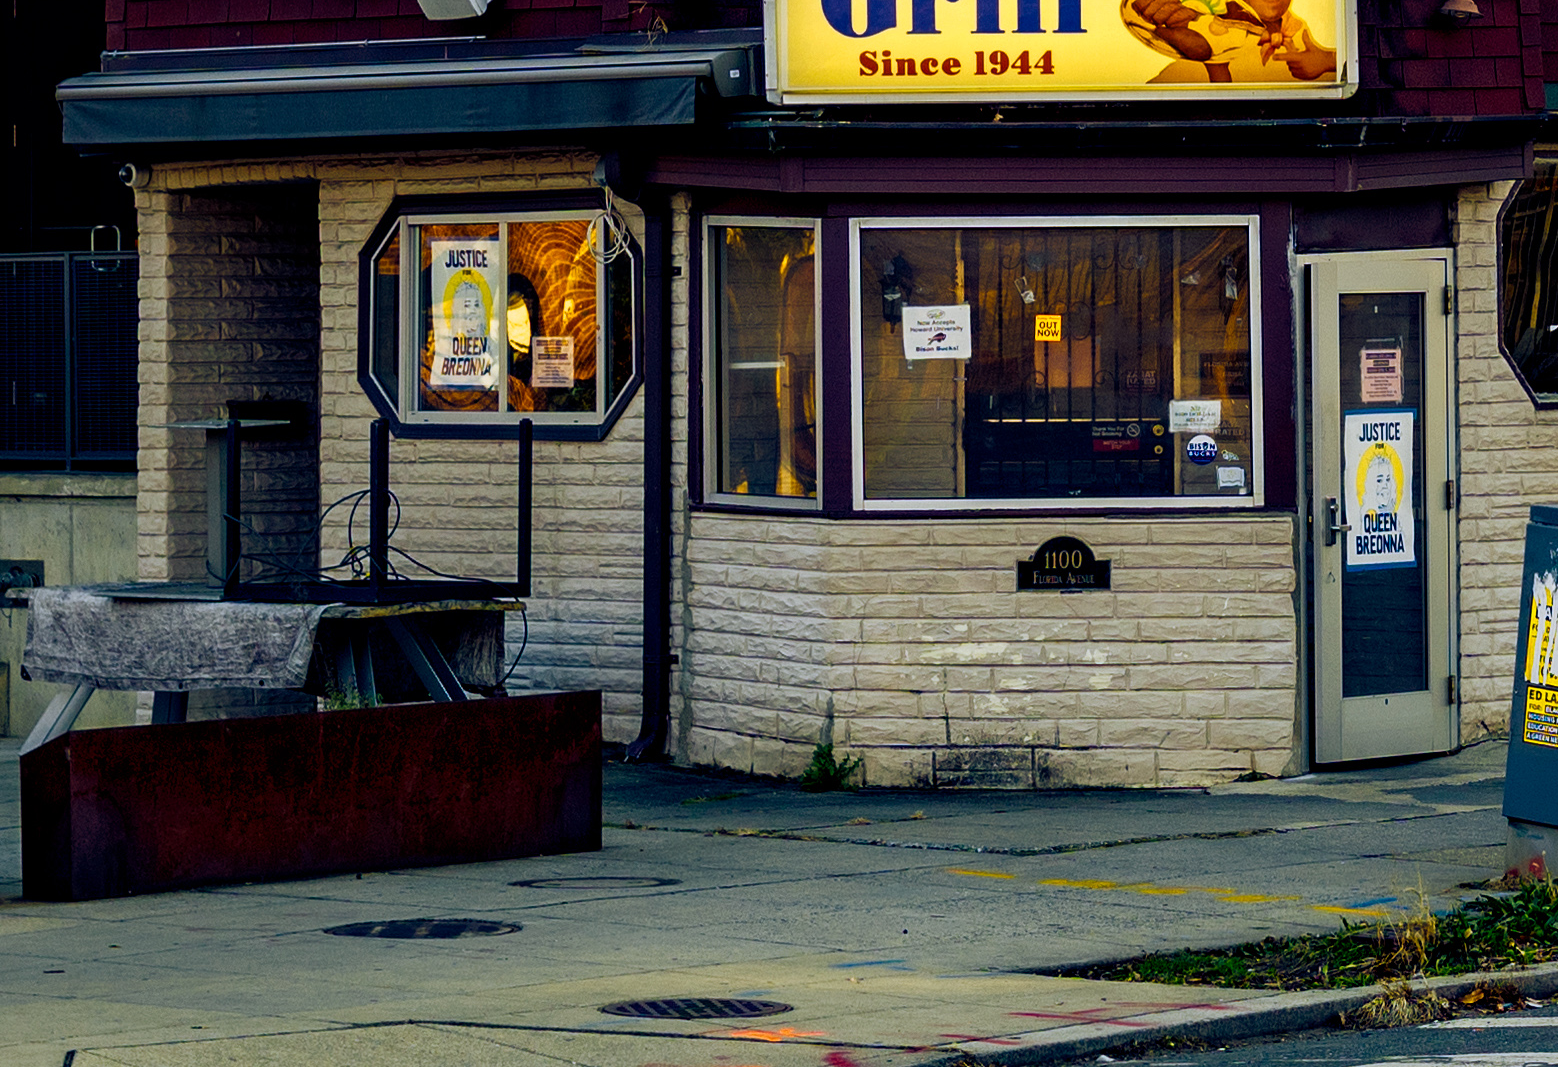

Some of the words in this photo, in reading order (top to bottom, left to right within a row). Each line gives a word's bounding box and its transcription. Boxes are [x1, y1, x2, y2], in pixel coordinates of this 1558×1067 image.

[859, 50, 961, 76] Since
[974, 50, 1055, 75] 1944
[445, 250, 488, 268] JUSTICE
[1038, 329, 1059, 337] NOW
[1039, 321, 1057, 329] OUT
[452, 336, 488, 355] QUEEN
[441, 357, 491, 376] BREONNA
[1359, 422, 1400, 442] JUSTICE
[1363, 512, 1398, 534] QUEEN
[1356, 533, 1405, 555] BREONNA
[1045, 549, 1082, 569] 1100
[1529, 690, 1542, 700] ED
